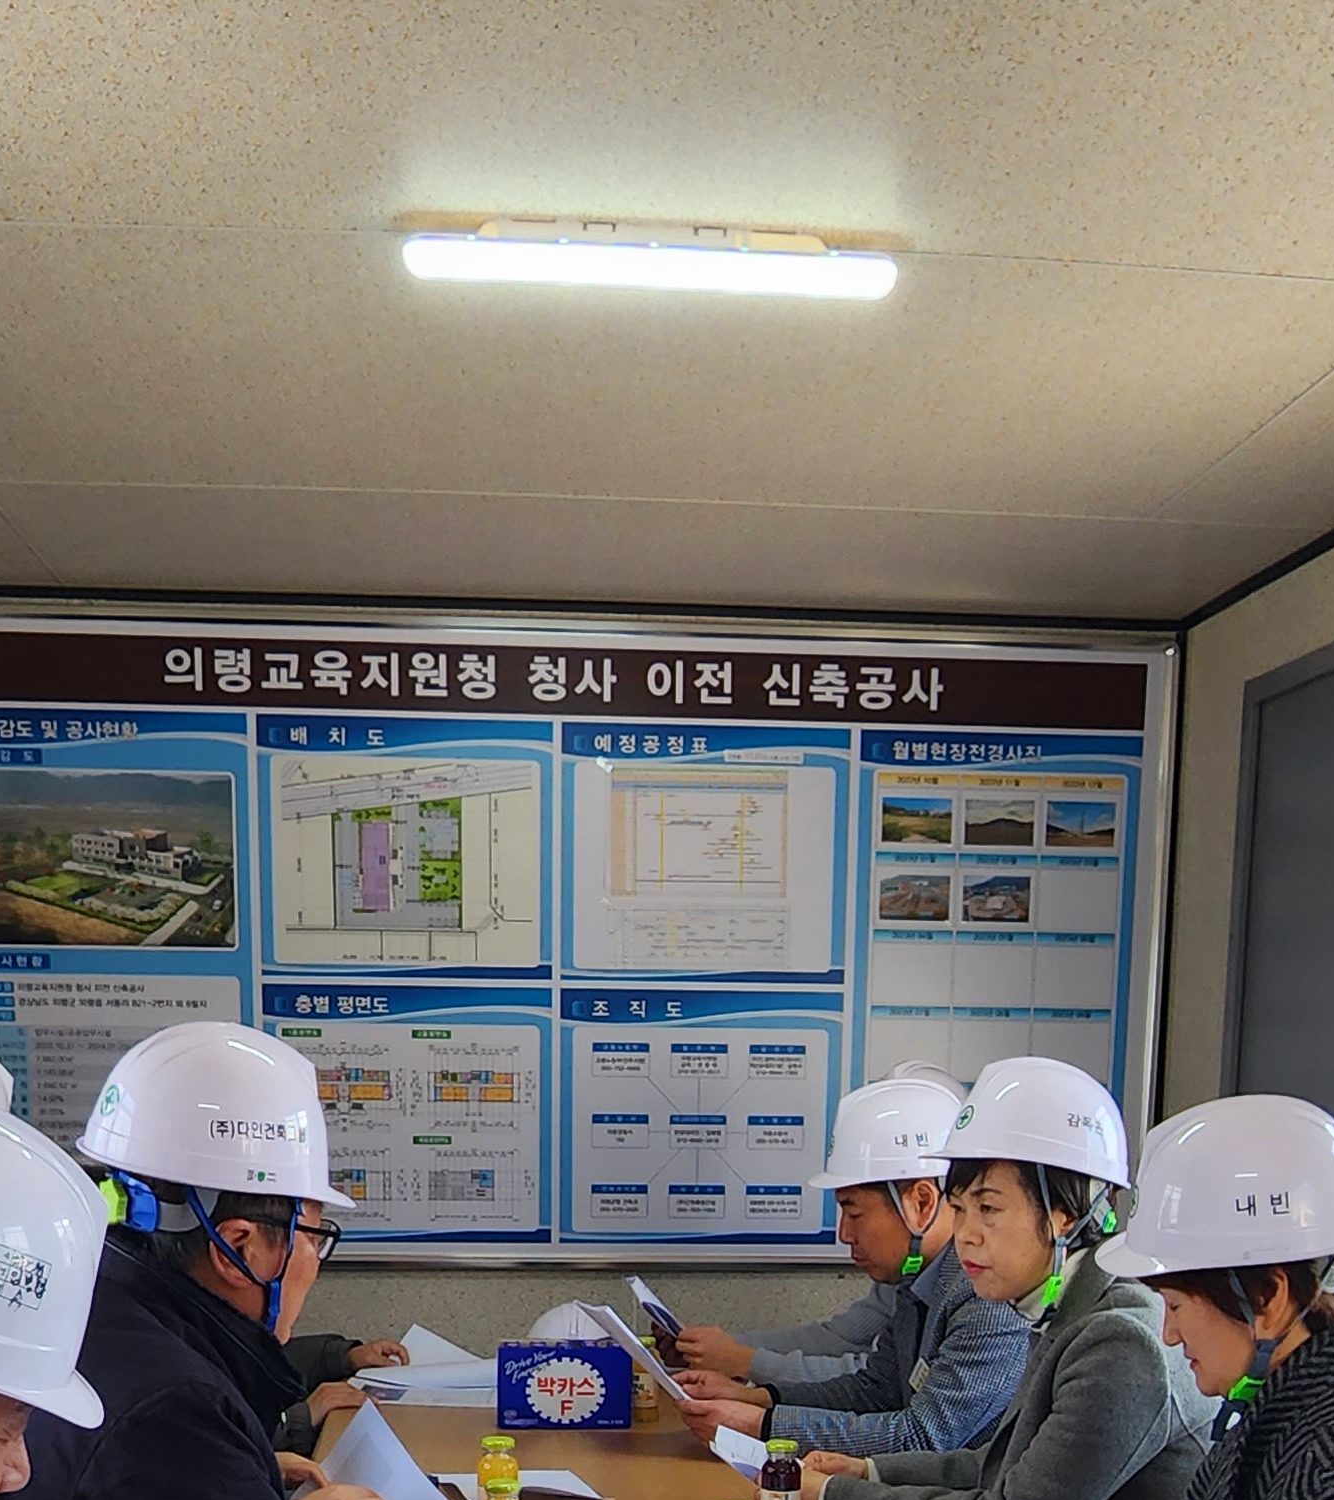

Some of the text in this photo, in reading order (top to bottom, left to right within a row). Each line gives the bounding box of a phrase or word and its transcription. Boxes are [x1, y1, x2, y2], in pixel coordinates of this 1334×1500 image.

[163, 646, 944, 711] 의령교육지원청 청사 이전 신축공사
[40, 720, 58, 739] 및
[66, 721, 139, 740] 공사현황
[594, 734, 708, 755] 예정공정표
[892, 741, 1042, 763] 월별현장전경사진
[295, 995, 390, 1014] 층별 평면도
[536, 1377, 596, 1397] 박카스
[560, 1400, 574, 1416] F
